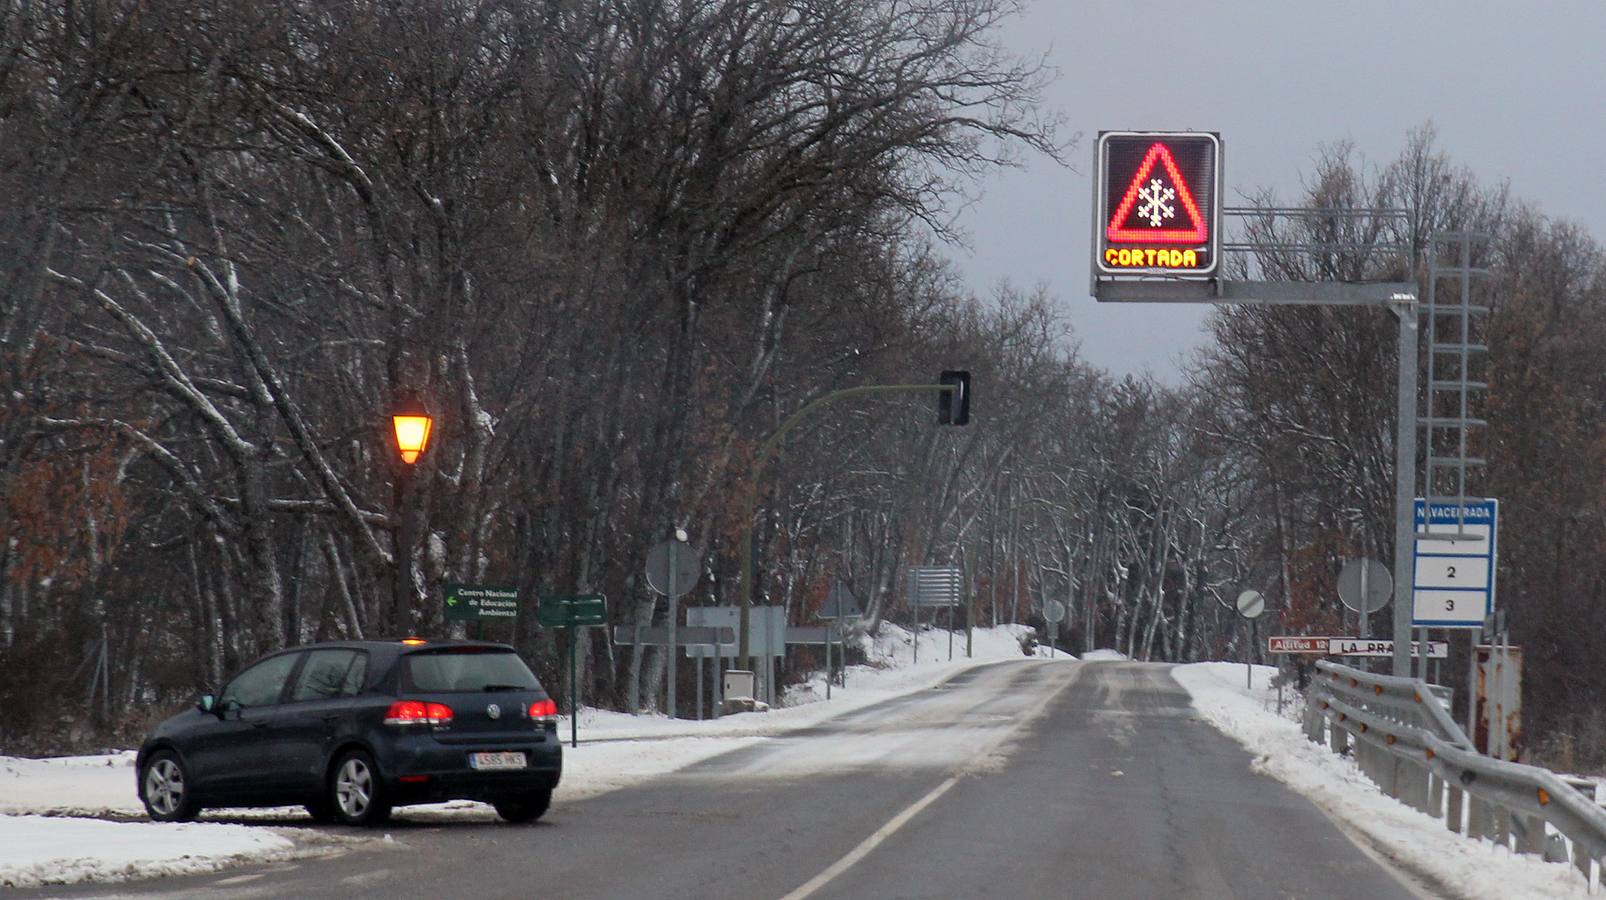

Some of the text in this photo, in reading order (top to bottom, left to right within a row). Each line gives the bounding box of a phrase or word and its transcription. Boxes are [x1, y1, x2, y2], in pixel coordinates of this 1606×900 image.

[1105, 248, 1197, 267] CORTADA
[1447, 566, 1456, 578] 2
[458, 588, 518, 598] Centro Nacional
[1445, 600, 1455, 612] 3
[479, 608, 517, 617] Ambiental
[1274, 639, 1311, 649] Altitud
[1341, 643, 1358, 654] LA
